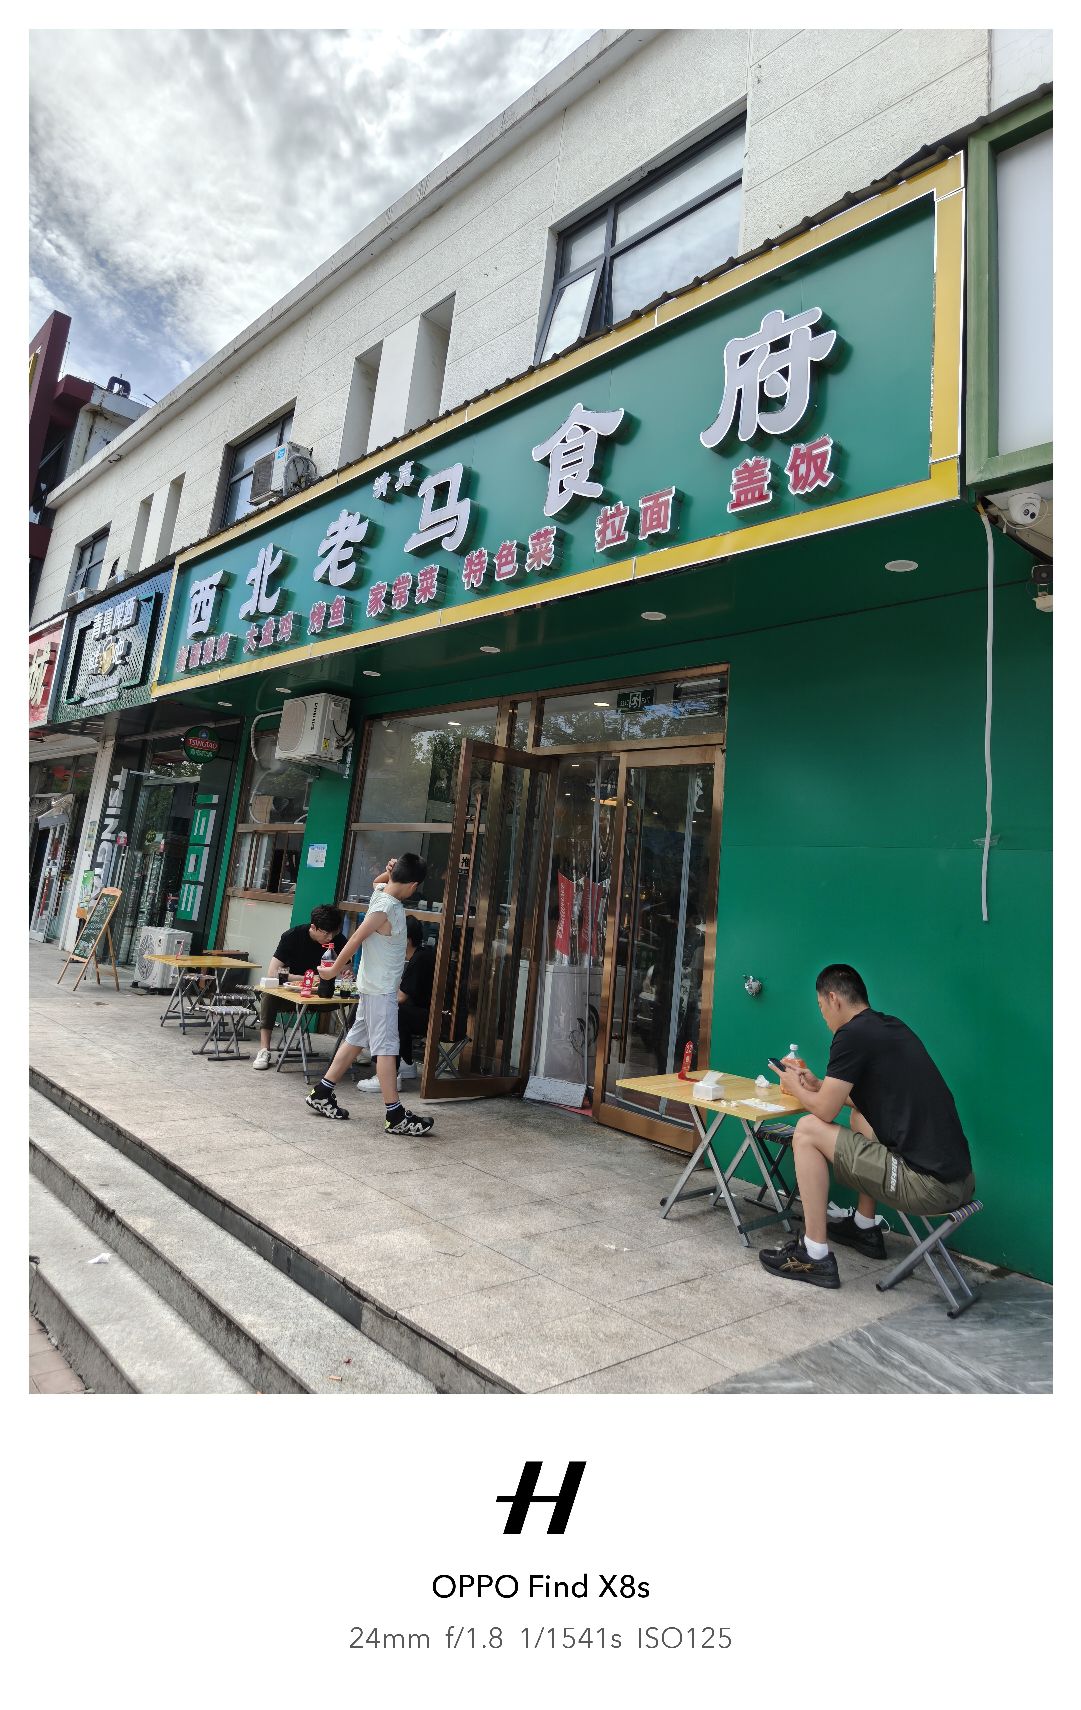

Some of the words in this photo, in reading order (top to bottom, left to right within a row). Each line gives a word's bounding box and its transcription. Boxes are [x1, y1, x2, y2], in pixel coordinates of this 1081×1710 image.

[186, 306, 836, 641] 西北老马食府
[243, 611, 294, 654] 大盘鸡
[307, 594, 346, 636] 烤鱼
[366, 563, 440, 618] 家常菜
[462, 525, 557, 590] 特色菜
[595, 486, 676, 552] 拉面
[727, 434, 834, 513] 盖饭
